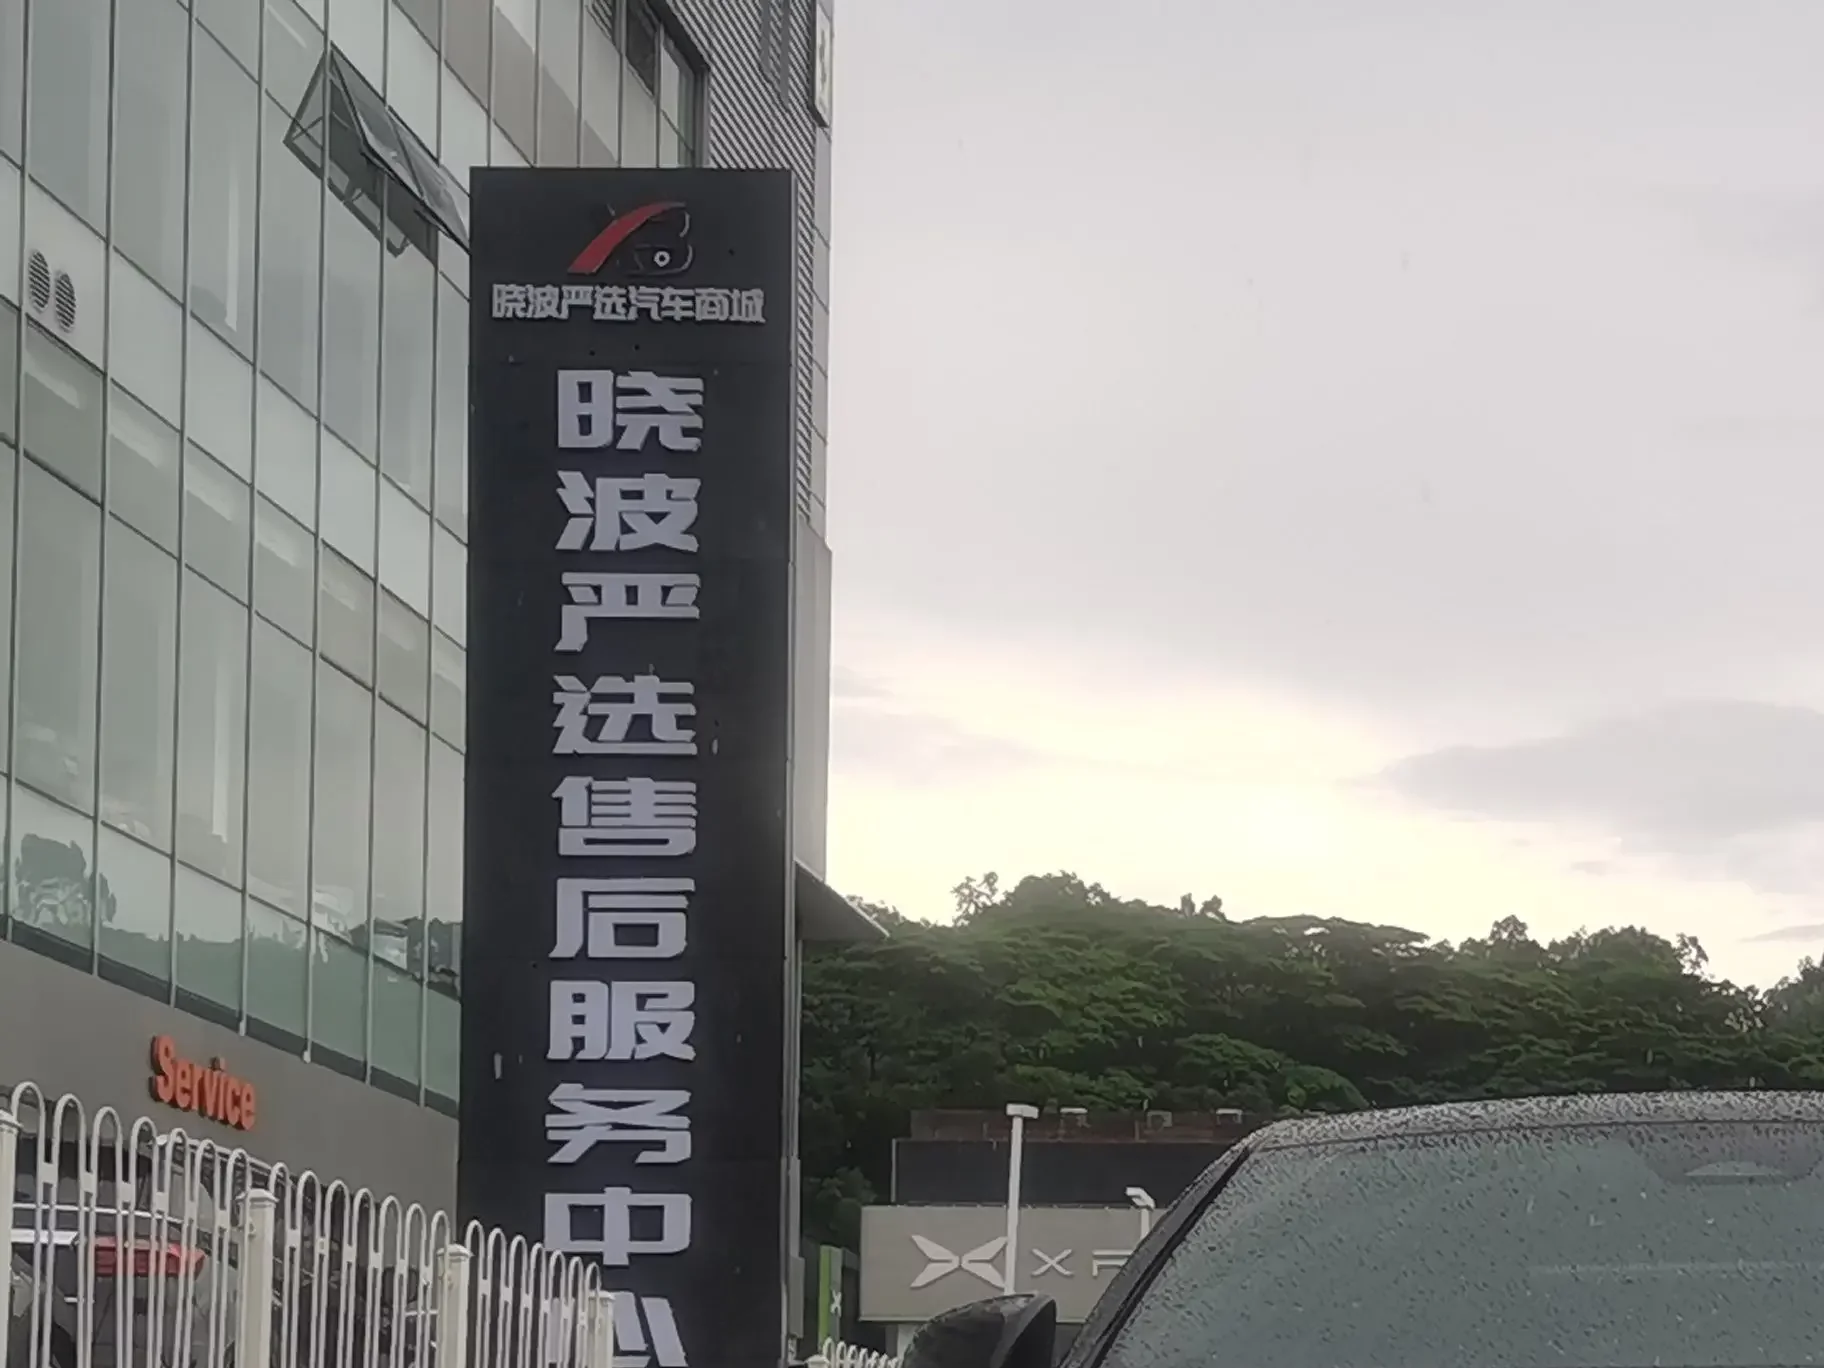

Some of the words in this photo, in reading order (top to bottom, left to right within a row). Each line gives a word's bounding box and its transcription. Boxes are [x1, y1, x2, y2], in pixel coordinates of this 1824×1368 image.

[492, 284, 766, 323] 晓波严选汽车商城
[151, 1035, 257, 1131] Service
